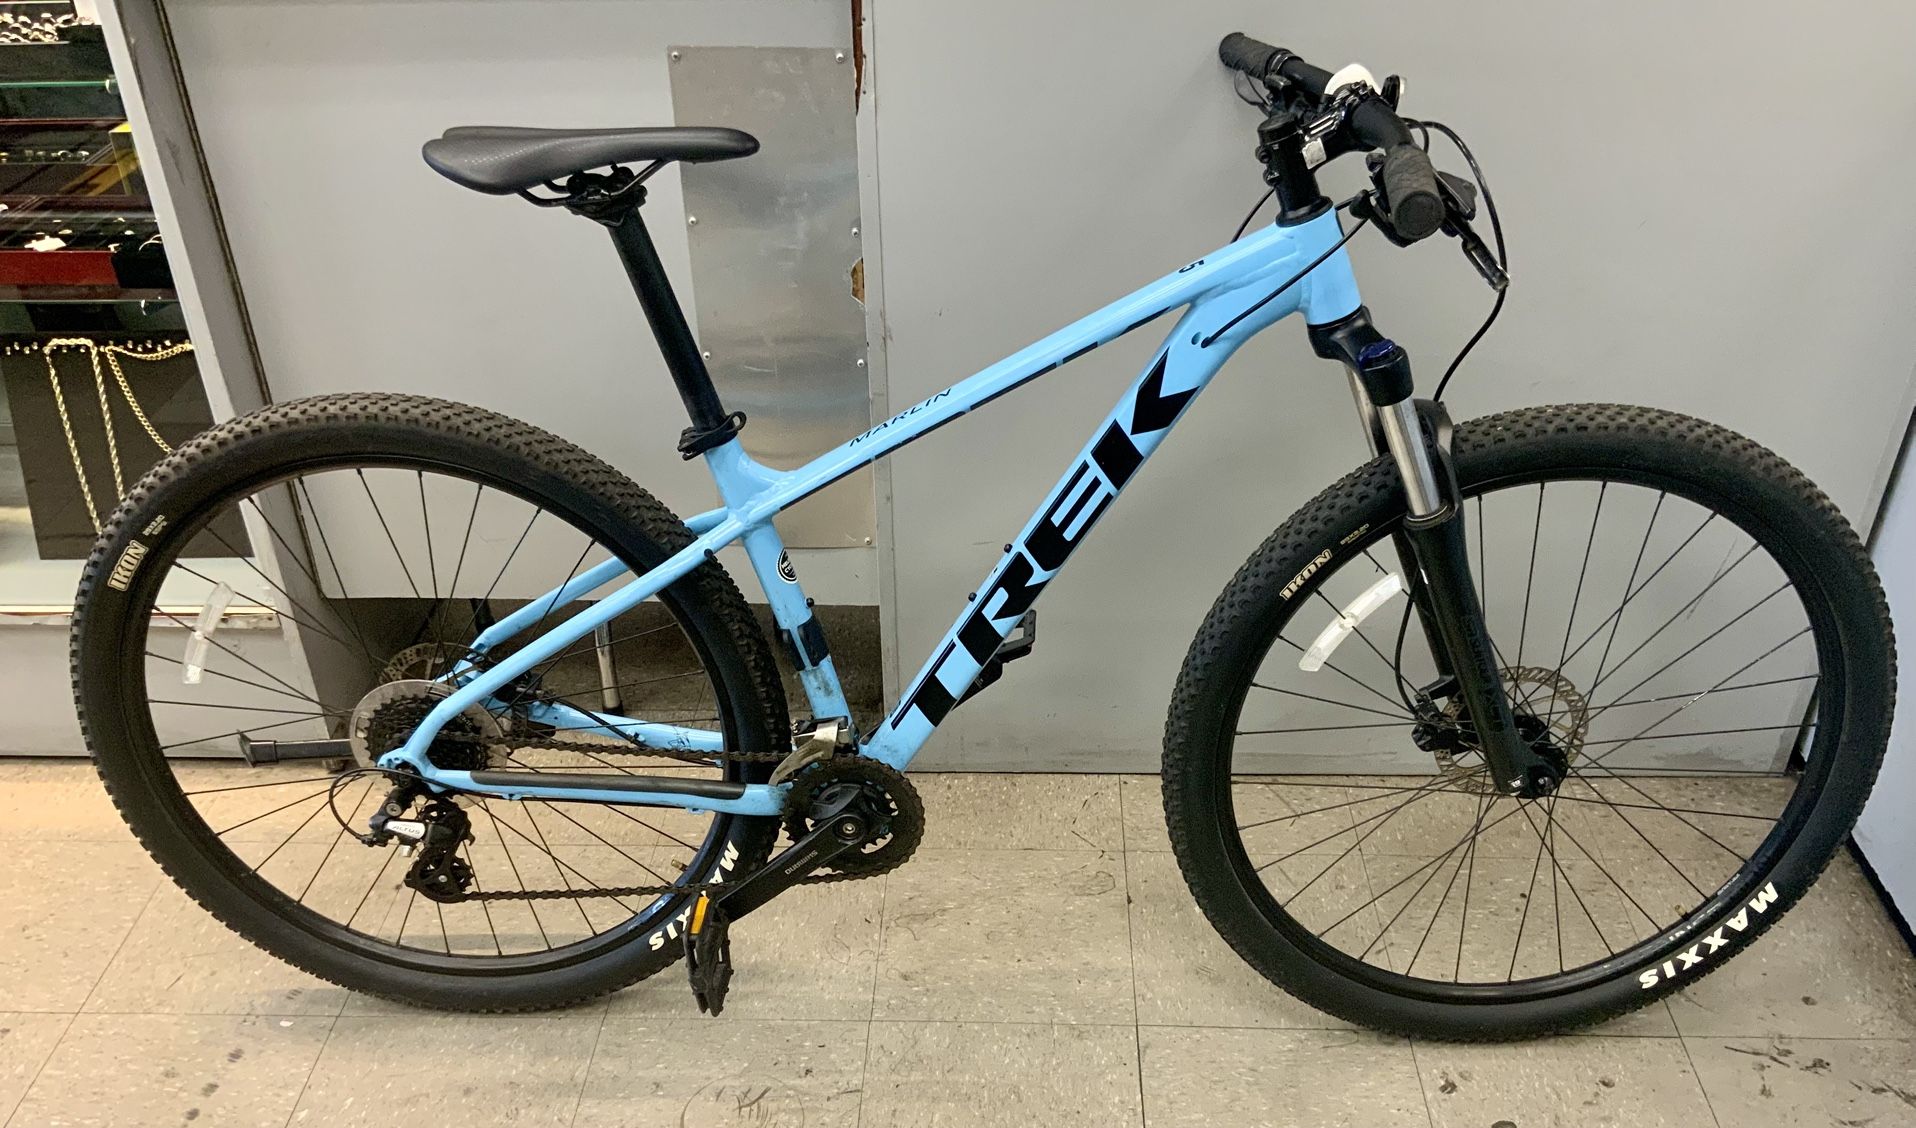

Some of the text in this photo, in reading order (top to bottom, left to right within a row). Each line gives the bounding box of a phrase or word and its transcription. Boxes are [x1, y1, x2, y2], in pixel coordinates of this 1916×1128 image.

[849, 388, 951, 447] MARLIN
[108, 540, 149, 591] IKON
[891, 345, 1200, 731] TREK
[1280, 548, 1333, 600] IKON
[1639, 881, 1779, 989] MAXXIS
